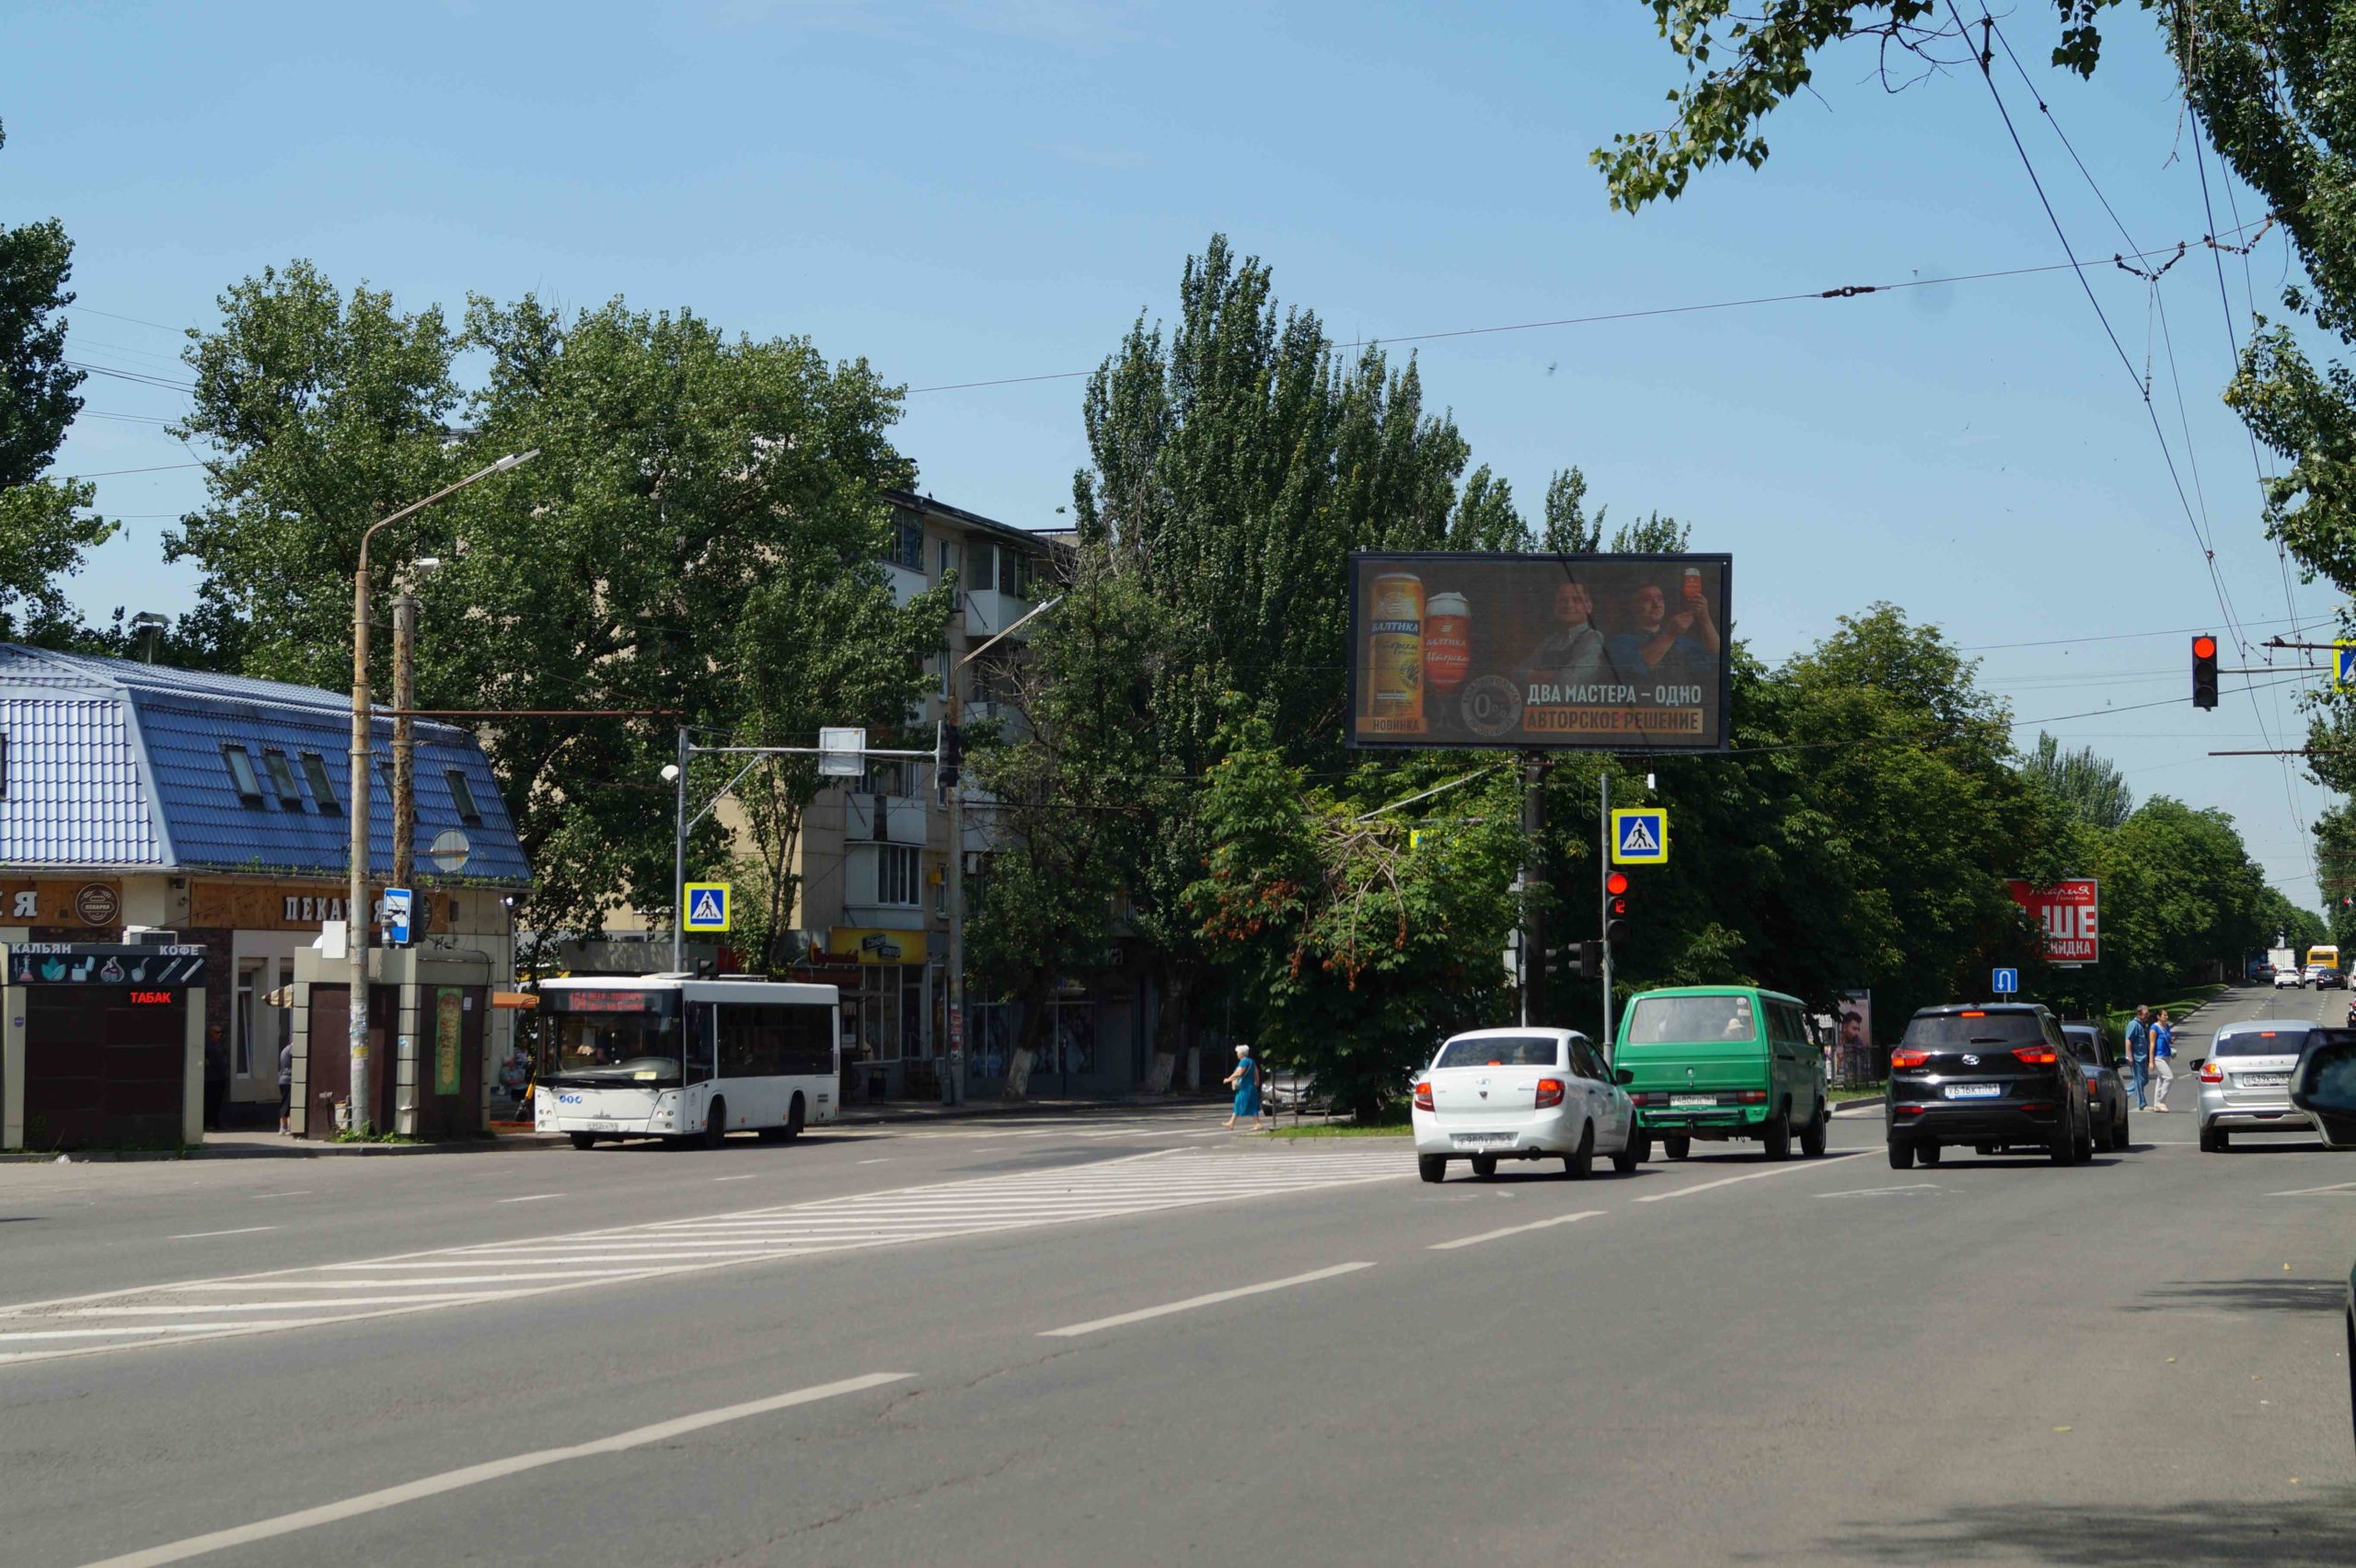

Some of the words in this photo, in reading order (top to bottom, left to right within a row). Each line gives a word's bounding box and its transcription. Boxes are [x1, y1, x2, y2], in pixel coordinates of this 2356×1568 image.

[1371, 621, 1419, 633] БАЛТИКА
[1527, 684, 1562, 705] ДВА
[1565, 685, 1637, 704] МАСТЕРА
[1655, 685, 1702, 707] ОДНО
[1372, 719, 1420, 732] НОВИНКА
[1526, 709, 1620, 730] АВТОРСКОЕ
[1623, 710, 1699, 730] РЕШЕНИЕ
[285, 896, 385, 923] ПЕКАЯ
[11, 943, 72, 954] КАЛЬЯН
[159, 945, 199, 956] КОФЕ
[2044, 940, 2091, 957] КИДКА
[130, 991, 171, 1004] ТАБАК
